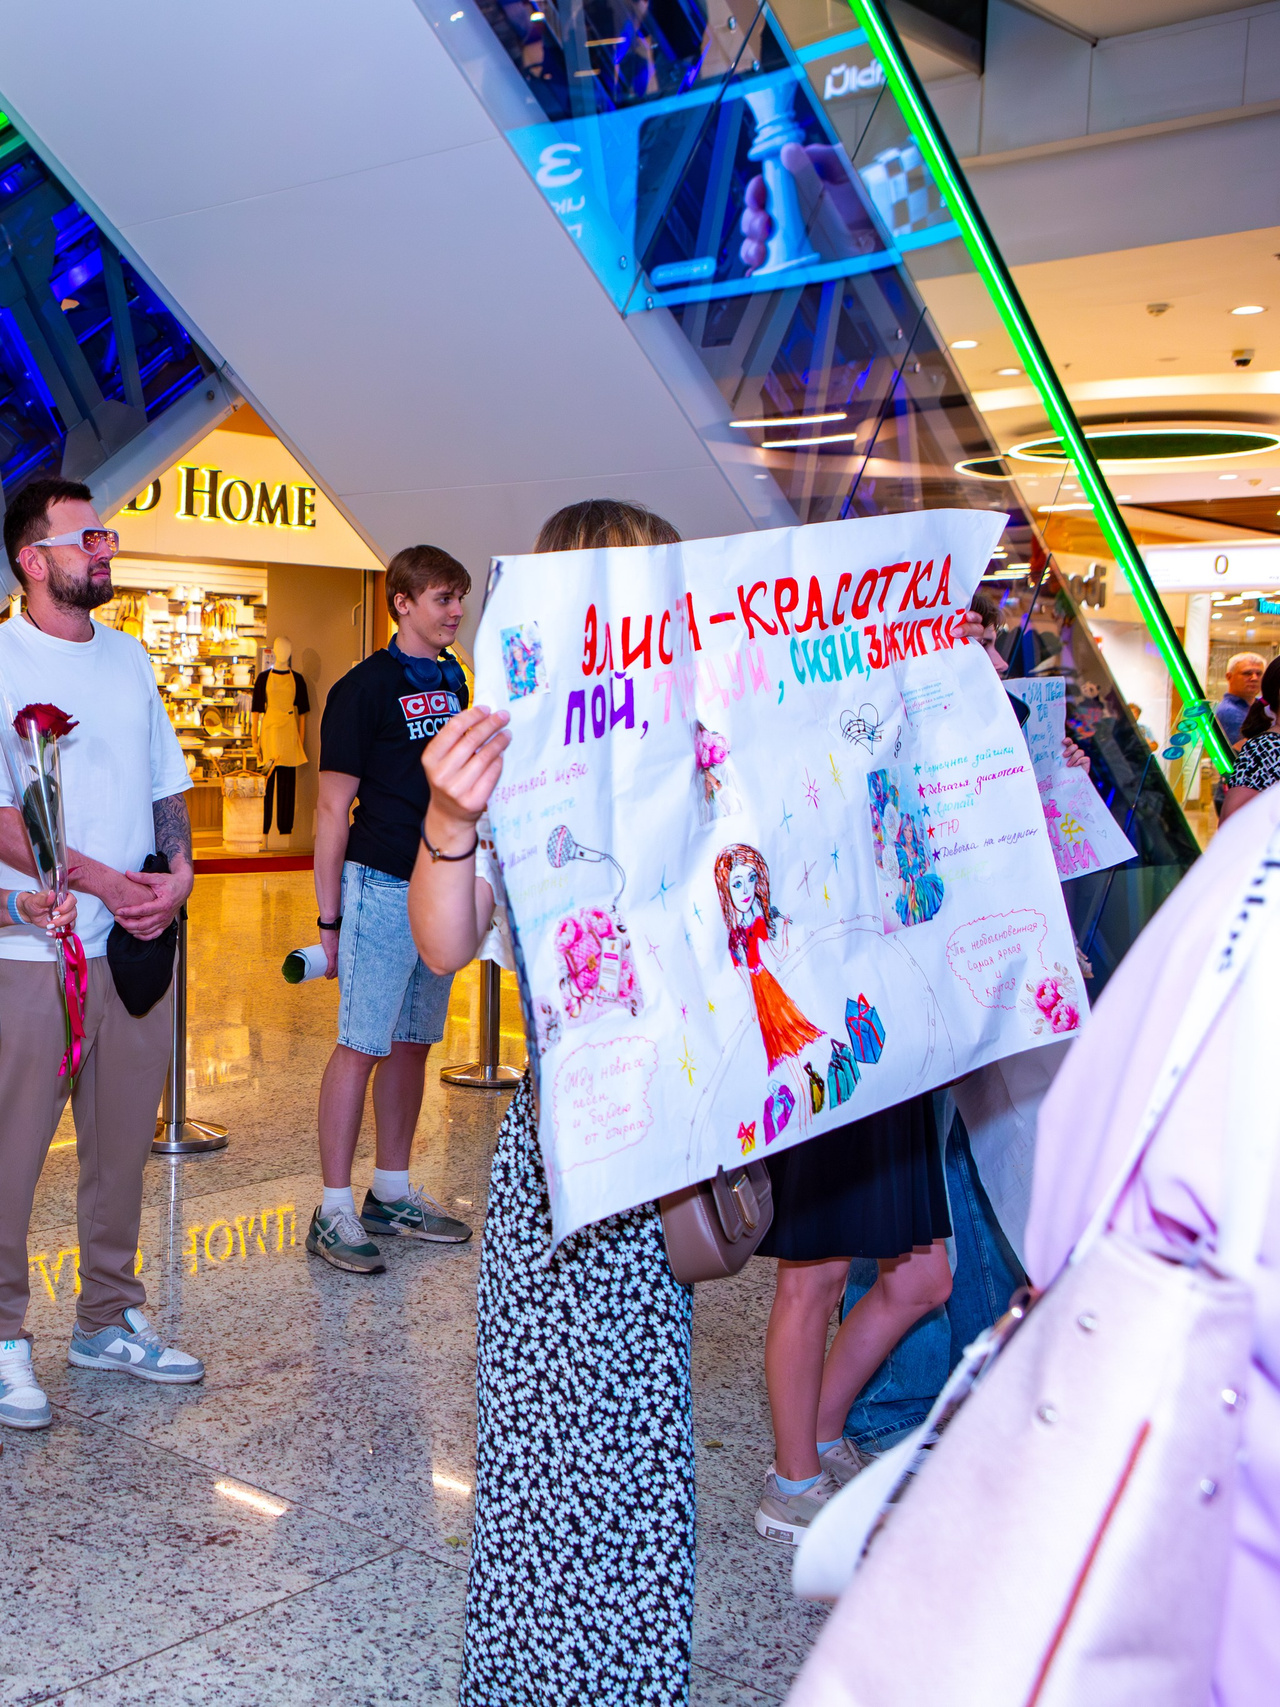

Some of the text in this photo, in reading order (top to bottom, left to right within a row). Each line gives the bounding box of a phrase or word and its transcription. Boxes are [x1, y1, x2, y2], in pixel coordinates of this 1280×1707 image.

[406, 694, 461, 716] CCM
[563, 671, 649, 746] ПОЙ,
[937, 818, 960, 838] ТЮ
